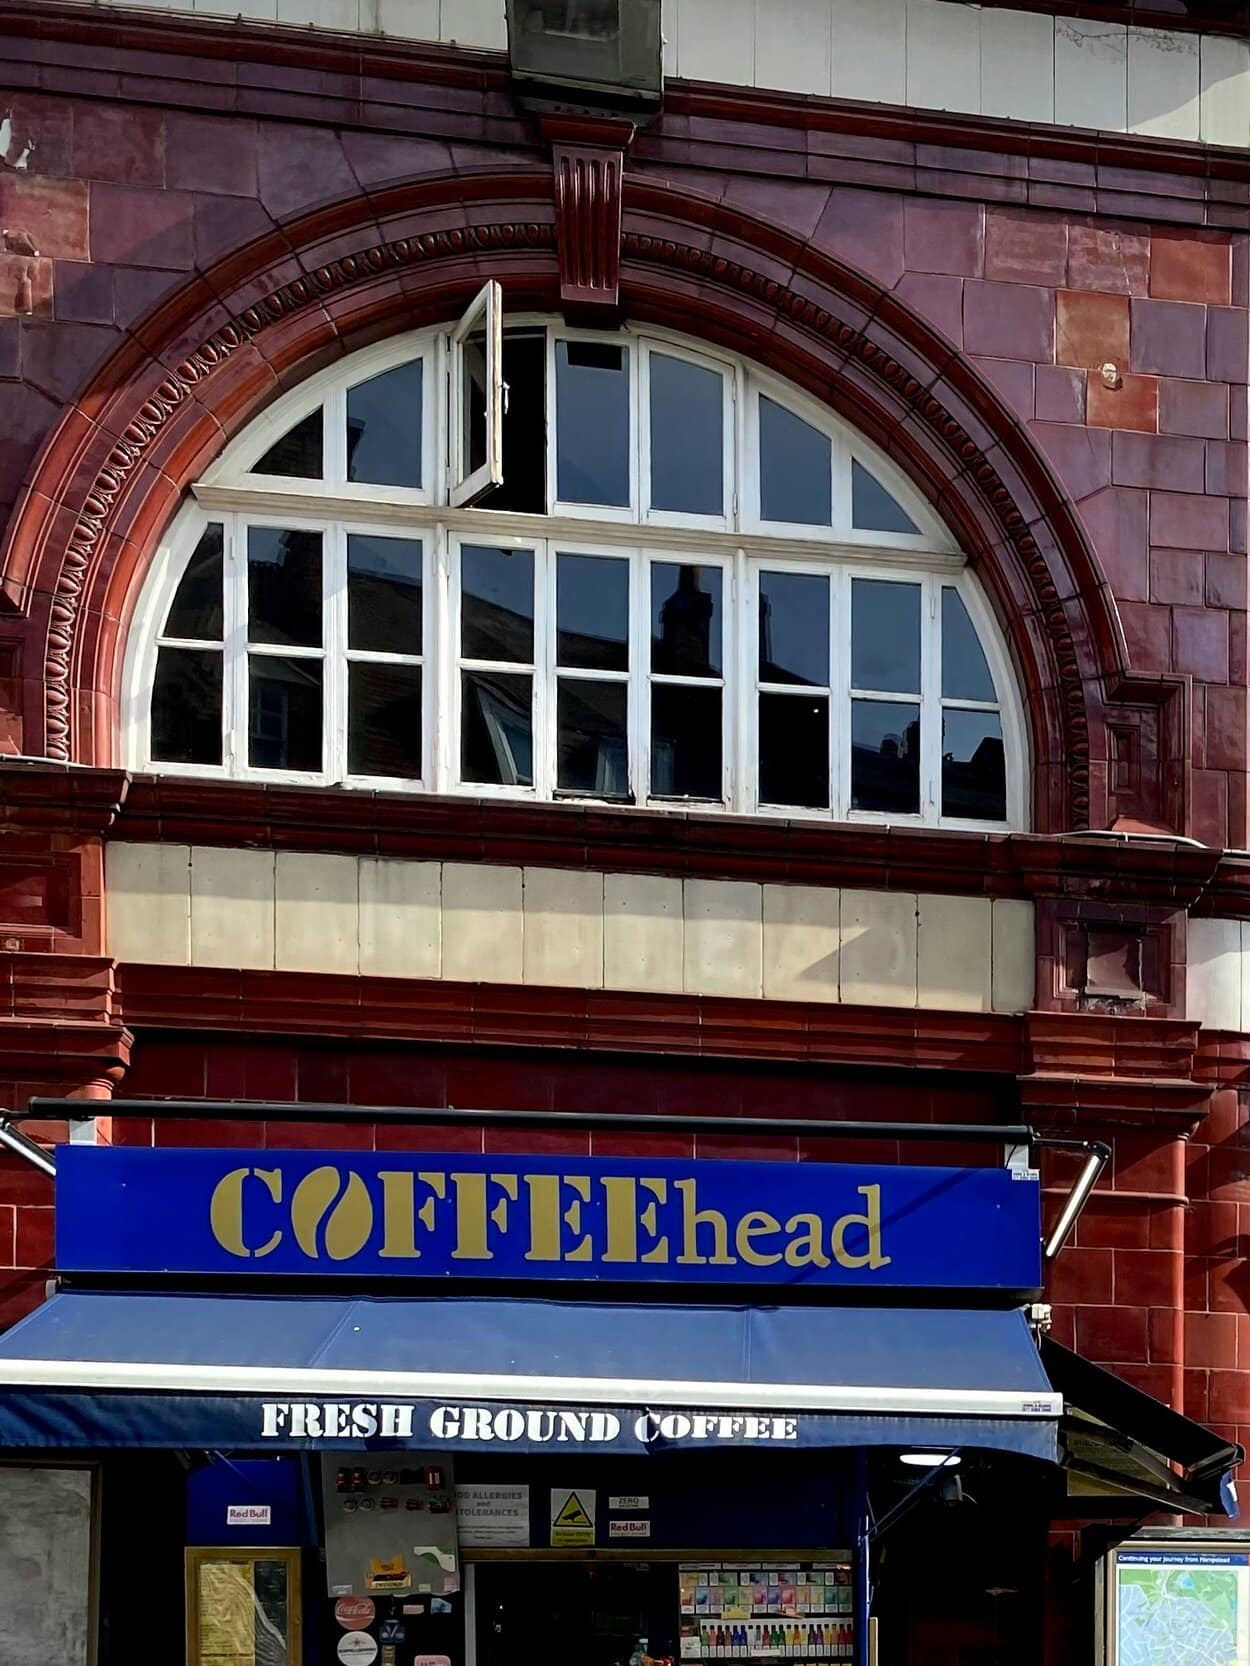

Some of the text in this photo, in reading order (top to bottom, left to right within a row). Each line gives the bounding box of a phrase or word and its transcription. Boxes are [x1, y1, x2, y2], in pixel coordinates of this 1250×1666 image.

[210, 1165, 892, 1270] COFFEEhead
[261, 1401, 799, 1444] FRESH GROUND COFFEE
[472, 1491, 523, 1500] ALLERGIES
[618, 1497, 639, 1505] ZERO
[230, 1509, 268, 1518] Red Bull
[455, 1508, 519, 1516] TOLERANCES
[610, 1522, 647, 1532] Red Bull
[1118, 1555, 1149, 1563] Continuing
[1162, 1556, 1184, 1564] journey
